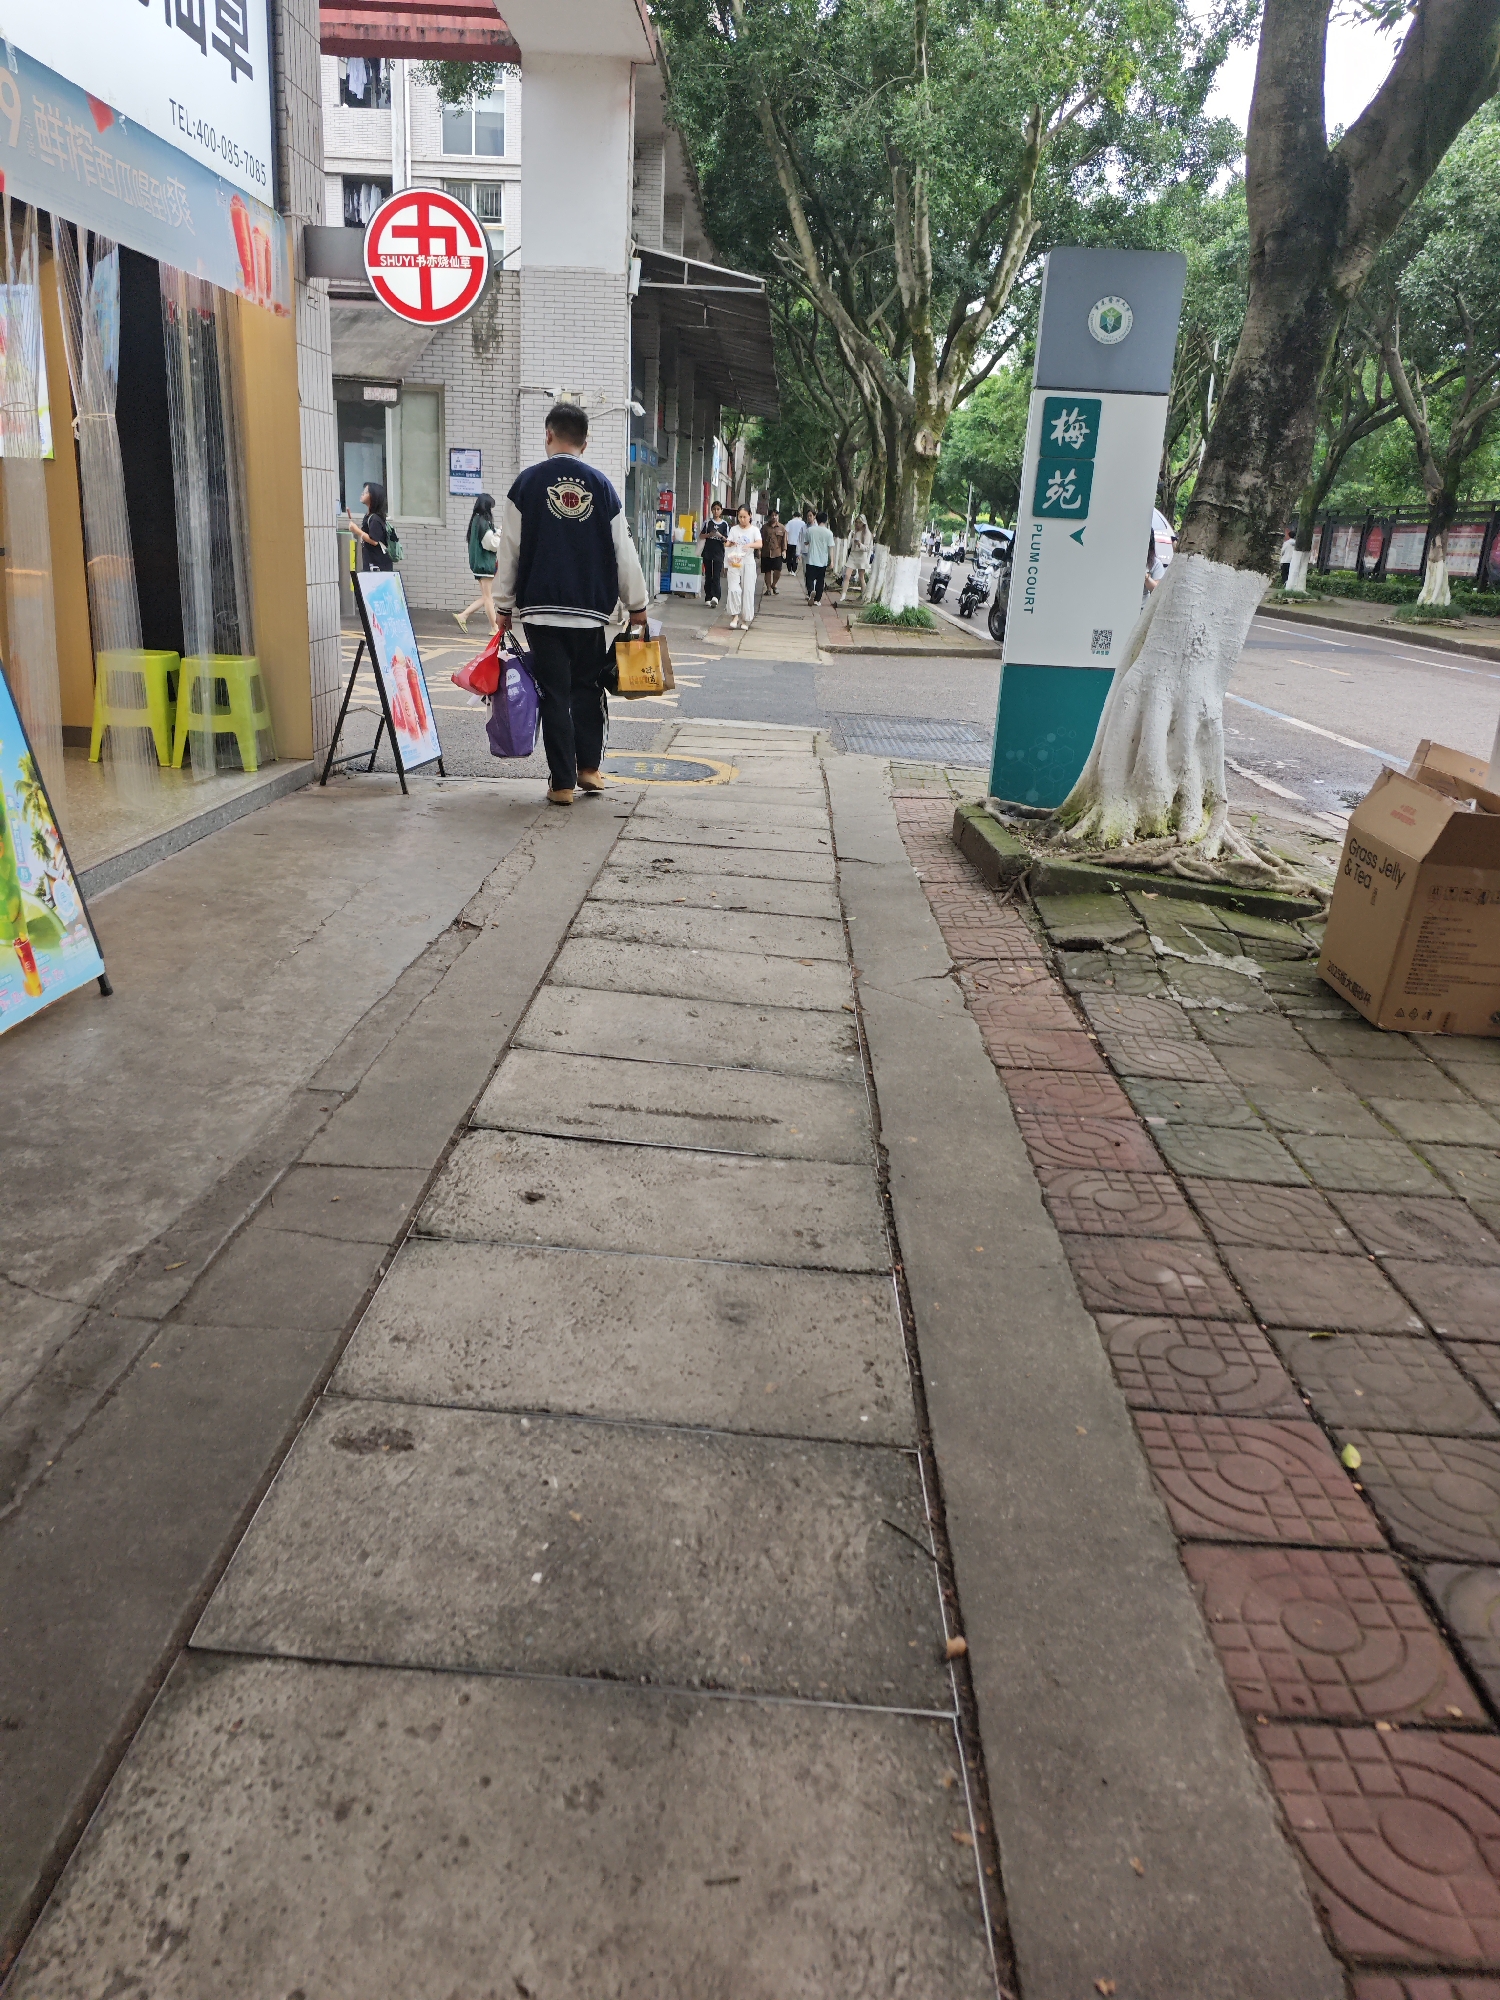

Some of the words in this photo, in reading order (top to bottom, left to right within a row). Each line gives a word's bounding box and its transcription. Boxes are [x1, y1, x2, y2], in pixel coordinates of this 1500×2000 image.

[168, 97, 267, 187] TEL:400-085-7085
[380, 255, 415, 267] SHUYI
[415, 254, 471, 269] 书亦烧仙草
[1041, 406, 1091, 511] 梅苑
[1028, 523, 1043, 563] PLUM
[1023, 566, 1038, 615] COURT
[1344, 857, 1353, 878] &
[1353, 862, 1373, 890] Tea
[1348, 837, 1378, 870] Grass
[1378, 856, 1407, 891] Jelly
